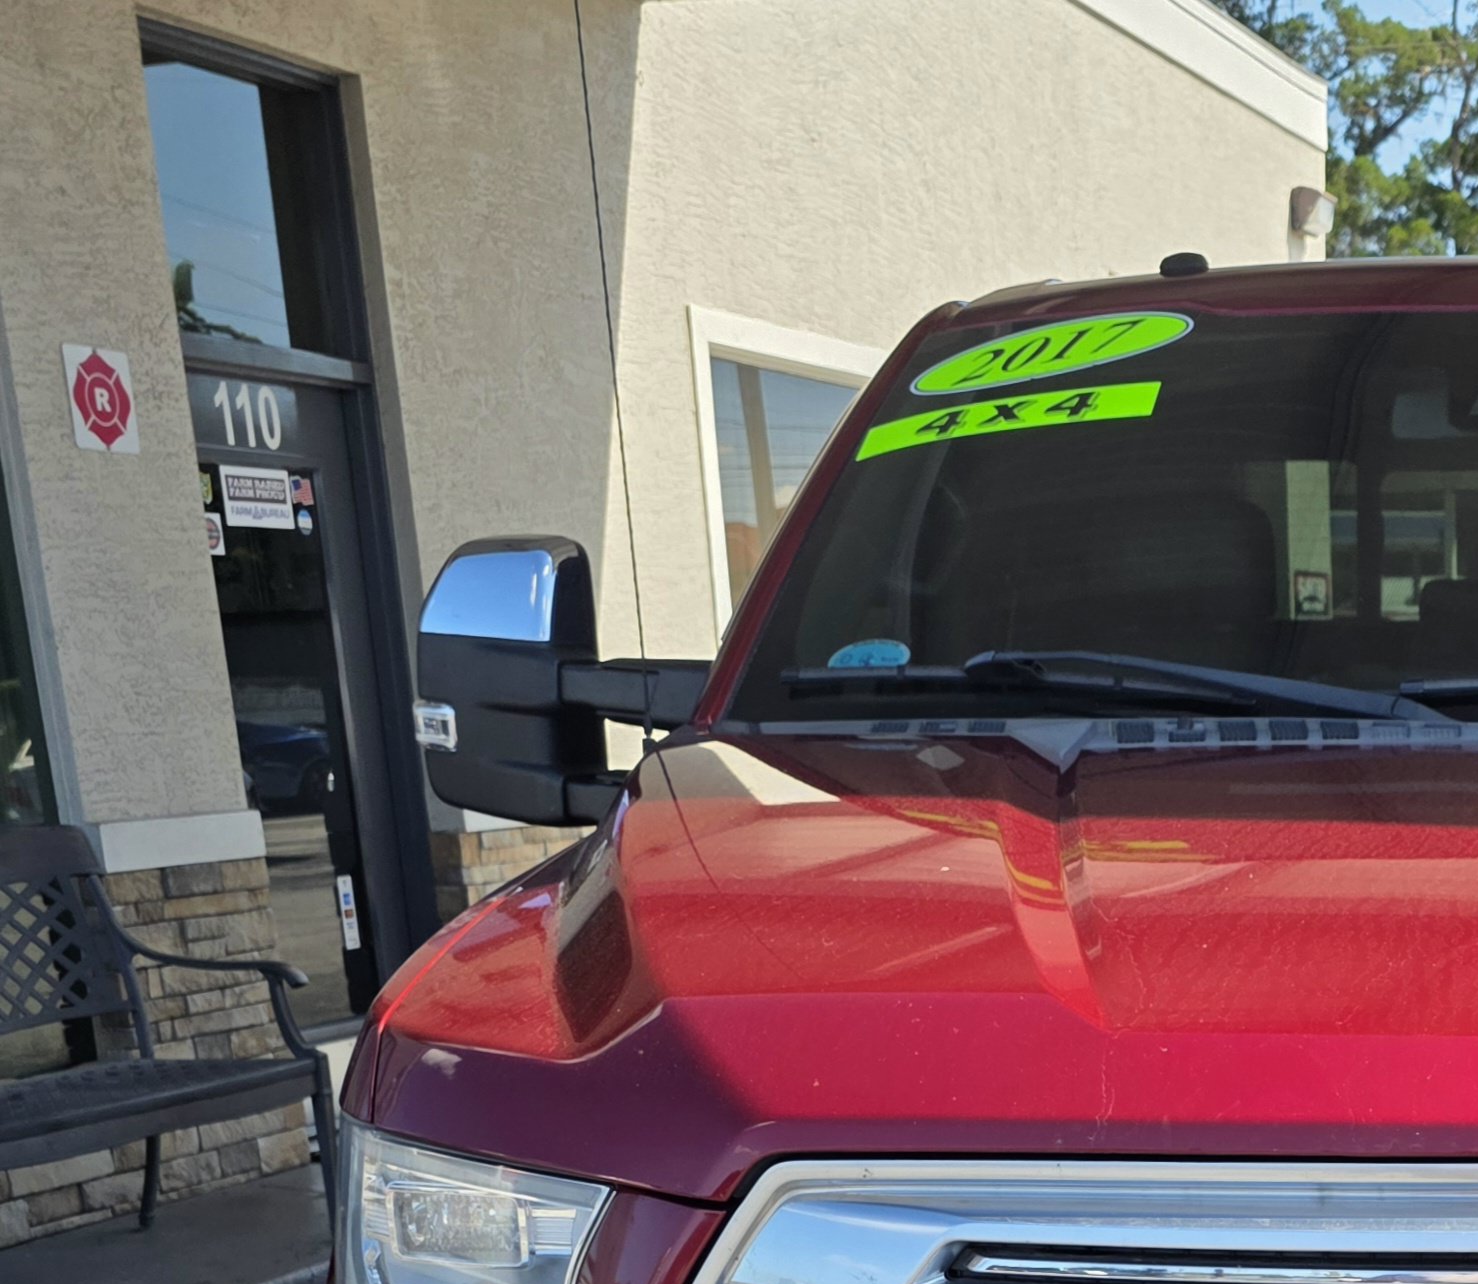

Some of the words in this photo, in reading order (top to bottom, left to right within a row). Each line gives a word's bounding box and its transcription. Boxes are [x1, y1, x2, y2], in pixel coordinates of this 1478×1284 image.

[951, 319, 1146, 386] 2017
[94, 387, 112, 412] R
[214, 381, 281, 450] 110
